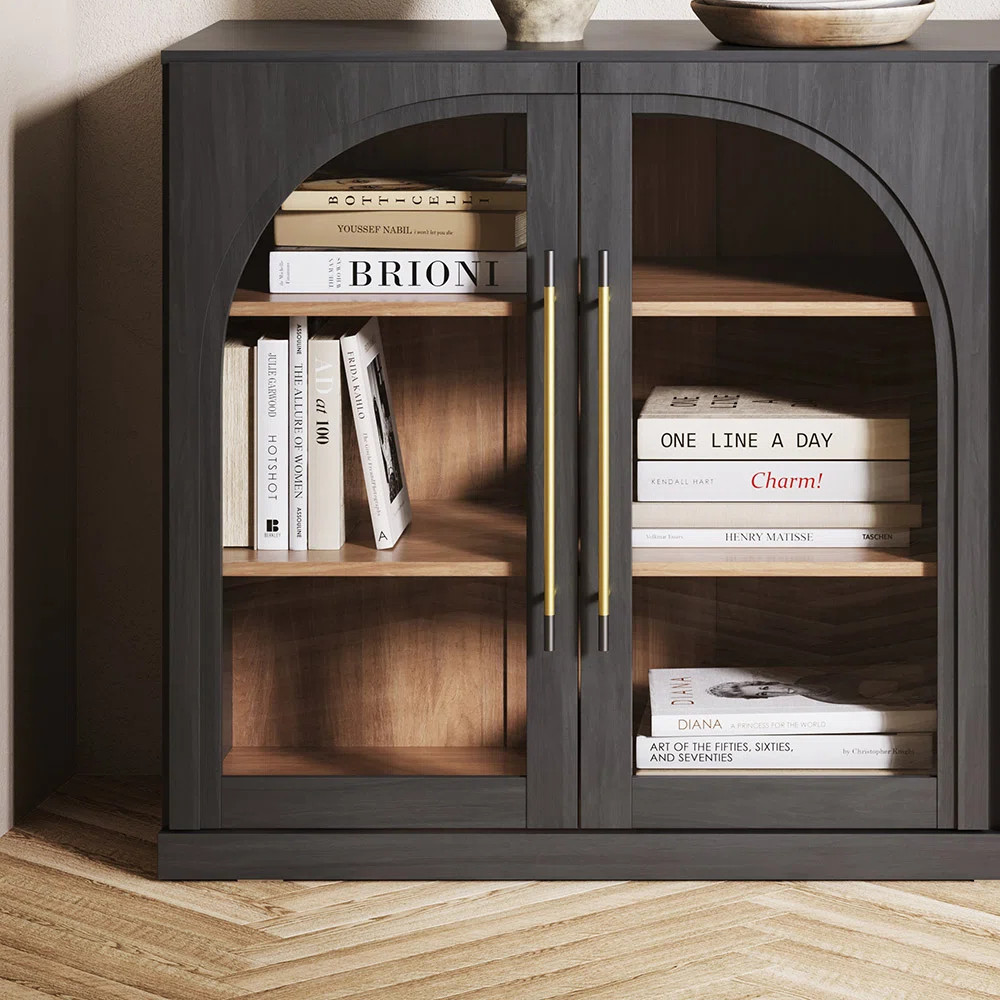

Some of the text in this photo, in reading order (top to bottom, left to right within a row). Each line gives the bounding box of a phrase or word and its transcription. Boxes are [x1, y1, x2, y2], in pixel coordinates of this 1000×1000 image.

[328, 195, 490, 205] BOTTICELLI
[337, 224, 381, 234] YOUSSEF
[383, 225, 412, 234] NABIL
[349, 260, 499, 287] BRIONI
[267, 353, 278, 418] JULIE GARWOOD
[347, 351, 366, 420] FRIDA KAHLO
[315, 358, 334, 445] AD at 100
[293, 363, 303, 499] THE ALLURE OF WOMEN
[660, 432, 833, 448] ONE LINE A DAY
[267, 435, 278, 501] HOTSHOT
[650, 478, 689, 486] KENDALL
[751, 471, 823, 489] Charm!
[725, 532, 814, 542] HENRY MATISSE
[862, 533, 893, 541] TASCHEN
[678, 719, 723, 730] DIANA
[650, 742, 794, 753] ART OF THE FIFTIES, SIXTIES,
[842, 748, 850, 756] by
[650, 752, 733, 762] AND SEVENTIES
